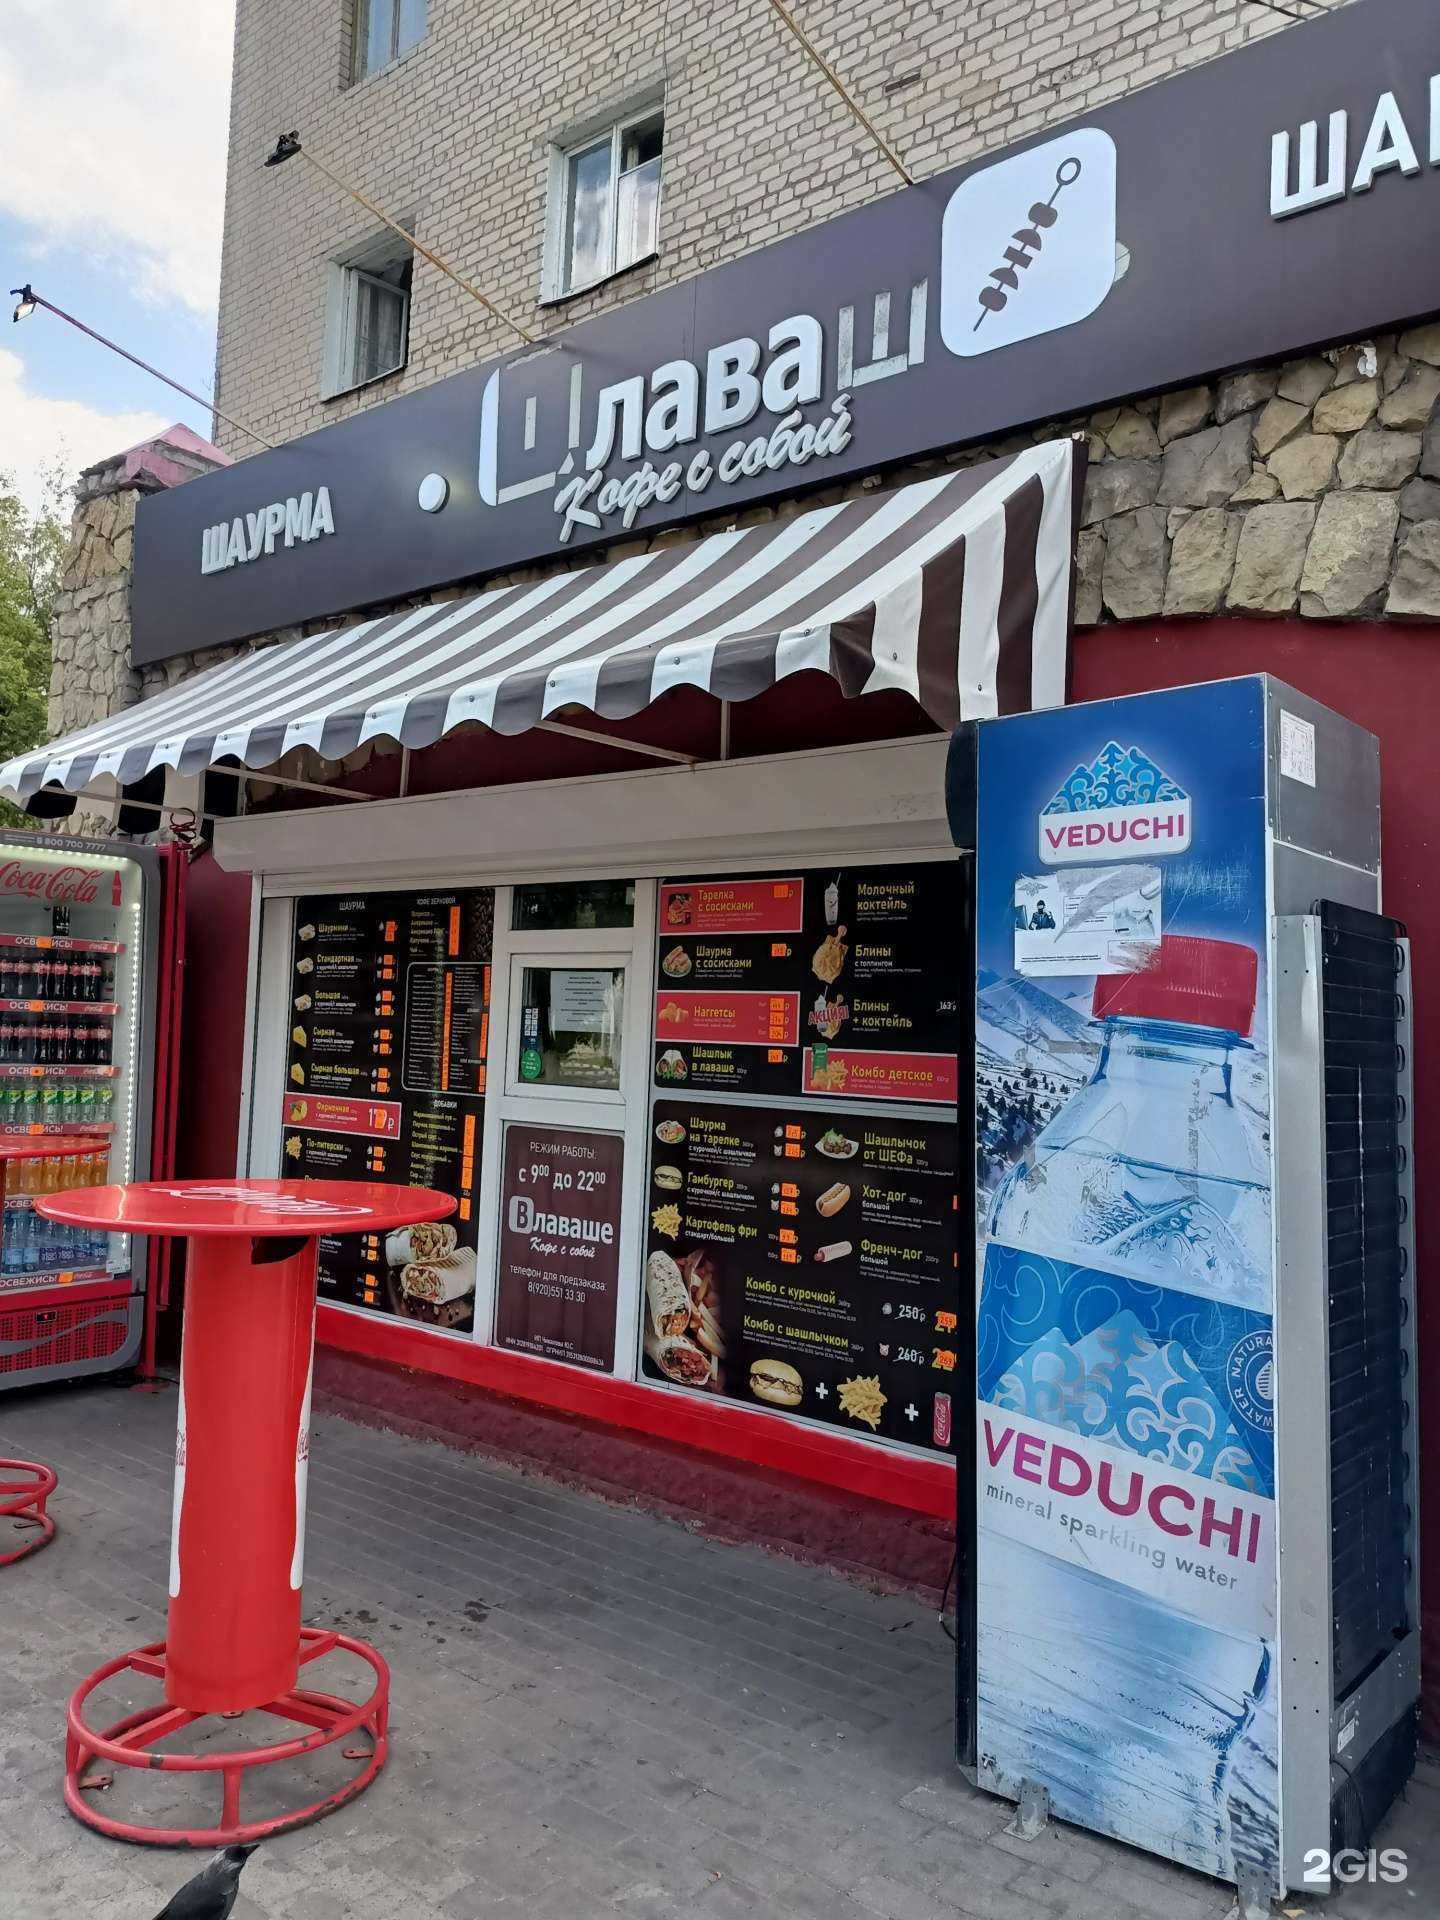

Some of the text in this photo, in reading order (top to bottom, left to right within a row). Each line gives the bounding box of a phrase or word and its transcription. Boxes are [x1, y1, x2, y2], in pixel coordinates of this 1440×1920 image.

[1270, 73, 1440, 219] ША
[554, 393, 852, 544] Кофе с собой
[201, 486, 335, 574] ШАУРМА
[1044, 813, 1185, 850] VEDUCHI
[699, 889, 735, 901] Тарелка
[857, 881, 915, 895] Молочный
[705, 901, 754, 912] сосисками
[857, 897, 907, 910] коктейль
[15, 935, 73, 949] ОСВИСЬ!
[696, 946, 732, 959] Шаурма
[855, 944, 892, 957] Блины
[703, 958, 752, 968] сосисками
[9, 1001, 69, 1012] ОСВИСЬ!
[694, 1006, 736, 1019] Наггетсы
[853, 999, 890, 1012] Блины
[862, 1014, 913, 1028] коктейль
[692, 1045, 733, 1060] Шашлык
[699, 1061, 735, 1074] лаваше
[851, 1065, 886, 1079] Комбо
[888, 1068, 934, 1082] детское
[689, 1117, 726, 1132] Шаурма
[689, 1134, 701, 1143] на
[703, 1133, 741, 1147] тарелке
[864, 1132, 926, 1151] Шашлычок
[529, 1141, 561, 1157] РЕЖИМ
[863, 1150, 876, 1160] от
[878, 1150, 913, 1165] ШЕФа
[518, 1168, 527, 1183] с
[552, 1174, 572, 1190] до
[687, 1171, 735, 1191] Гамбургер
[862, 1184, 907, 1203] Хот-дог
[862, 1200, 890, 1211] большой
[508, 1195, 614, 1245] Влаваше
[685, 1215, 758, 1237] Картофель фри
[530, 1236, 596, 1258] Кофе с собой
[860, 1238, 923, 1260] Френч-дог
[860, 1254, 889, 1266] большой
[510, 1264, 542, 1279] телефон
[542, 1270, 558, 1282] для
[745, 1276, 777, 1295] Комбо
[779, 1284, 786, 1296] с
[787, 1286, 837, 1305] курочкой
[743, 1315, 776, 1335] Комбо
[777, 1323, 784, 1335] с
[785, 1325, 849, 1348] шашлычком
[983, 1418, 1261, 1564] VEDUCHI
[986, 1481, 1238, 1590] mineral sparkling water
